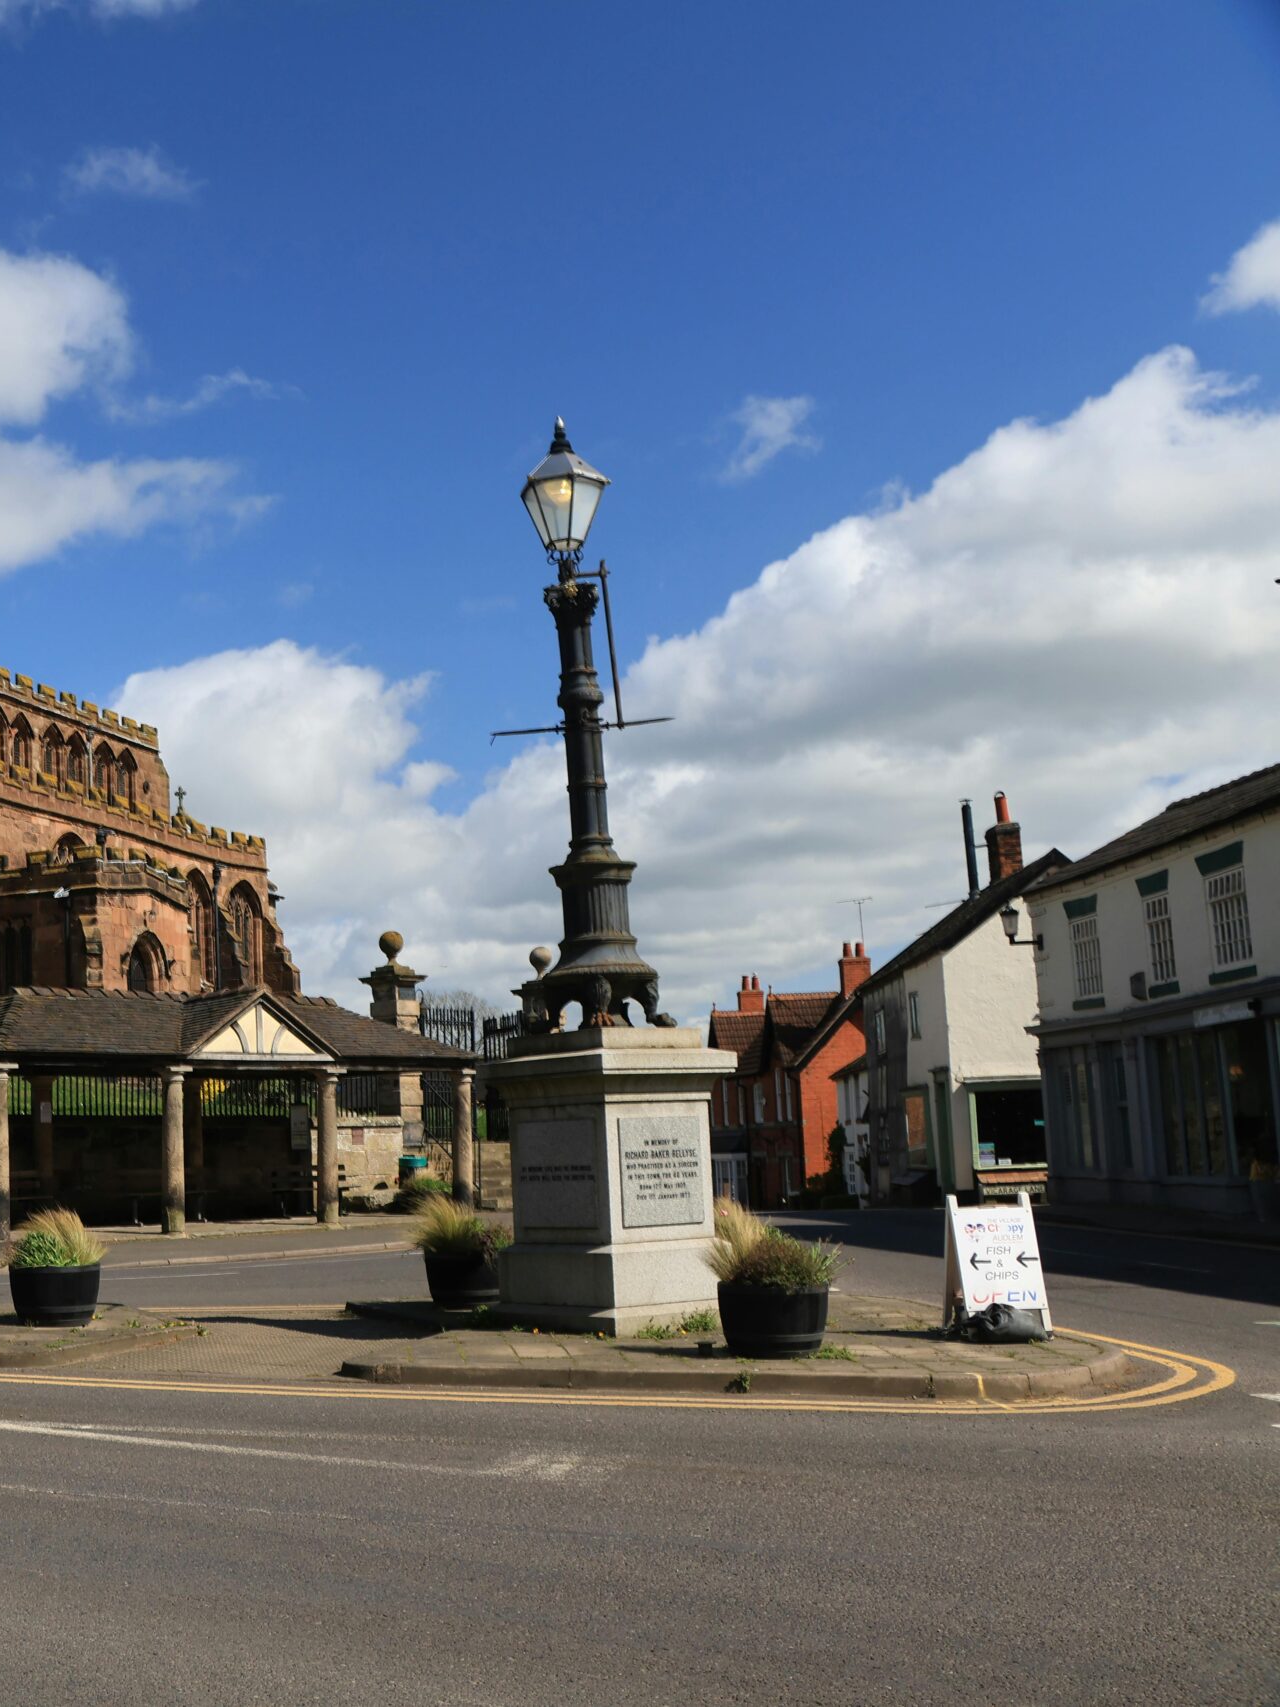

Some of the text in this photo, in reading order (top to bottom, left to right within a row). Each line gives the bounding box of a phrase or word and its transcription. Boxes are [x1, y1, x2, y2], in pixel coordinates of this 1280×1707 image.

[625, 1151, 648, 1159] RICHARD
[651, 1150, 669, 1158] BAKER
[986, 1246, 1011, 1255] FISH
[996, 1259, 1004, 1268] &
[985, 1271, 1019, 1281] CHIPS
